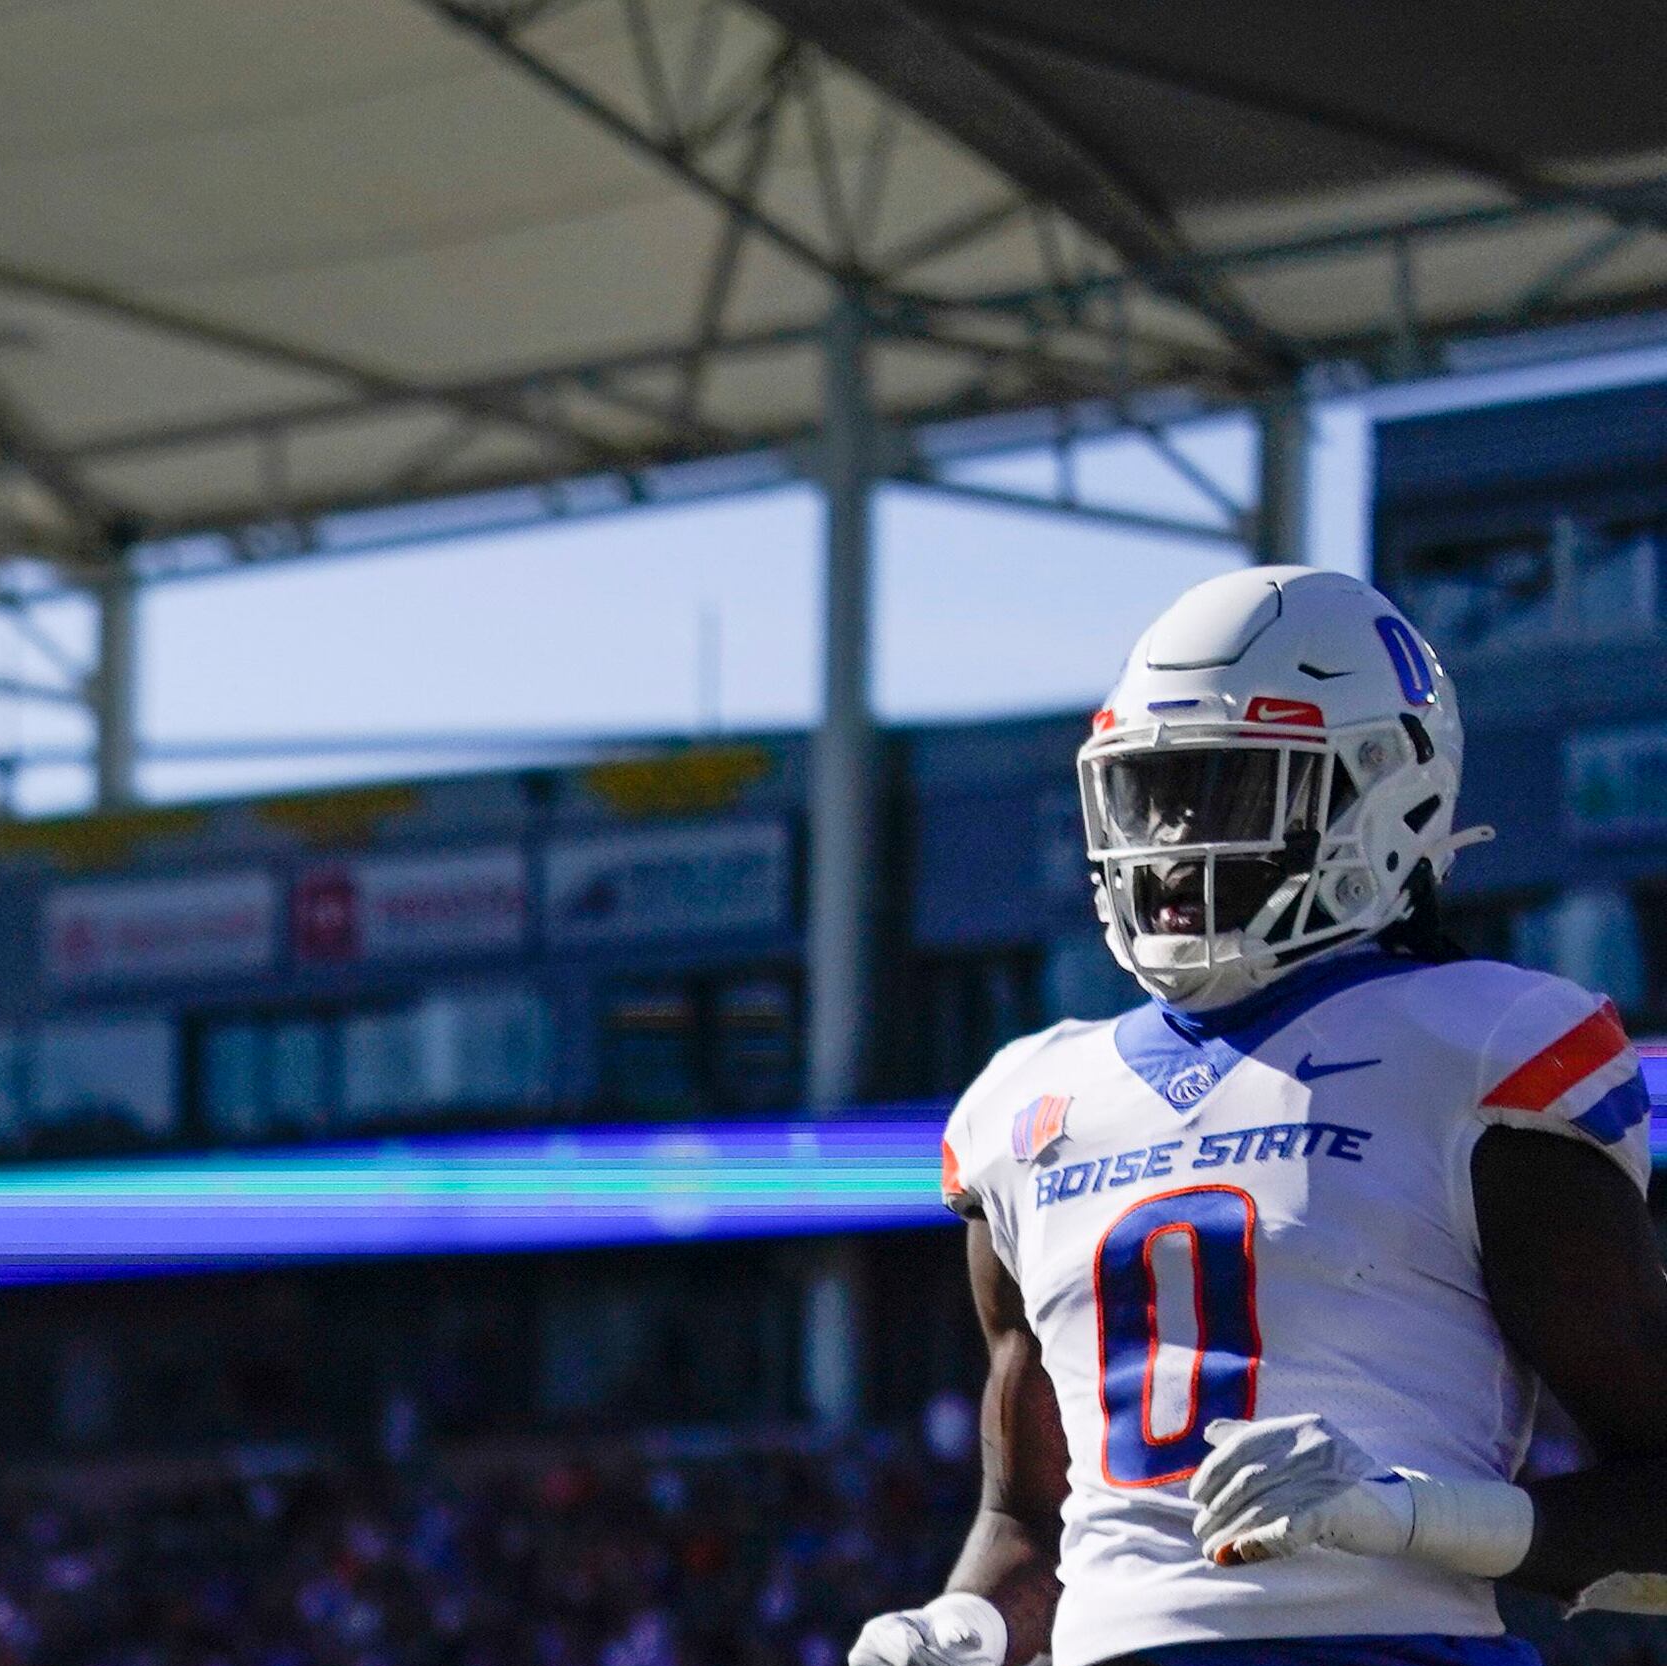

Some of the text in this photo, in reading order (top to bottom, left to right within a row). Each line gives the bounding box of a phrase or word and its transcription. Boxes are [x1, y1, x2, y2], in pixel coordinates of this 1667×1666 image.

[1374, 615, 1435, 707] 0
[1034, 1121, 1373, 1212] BOISE STATE
[1093, 1183, 1263, 1489] 0
